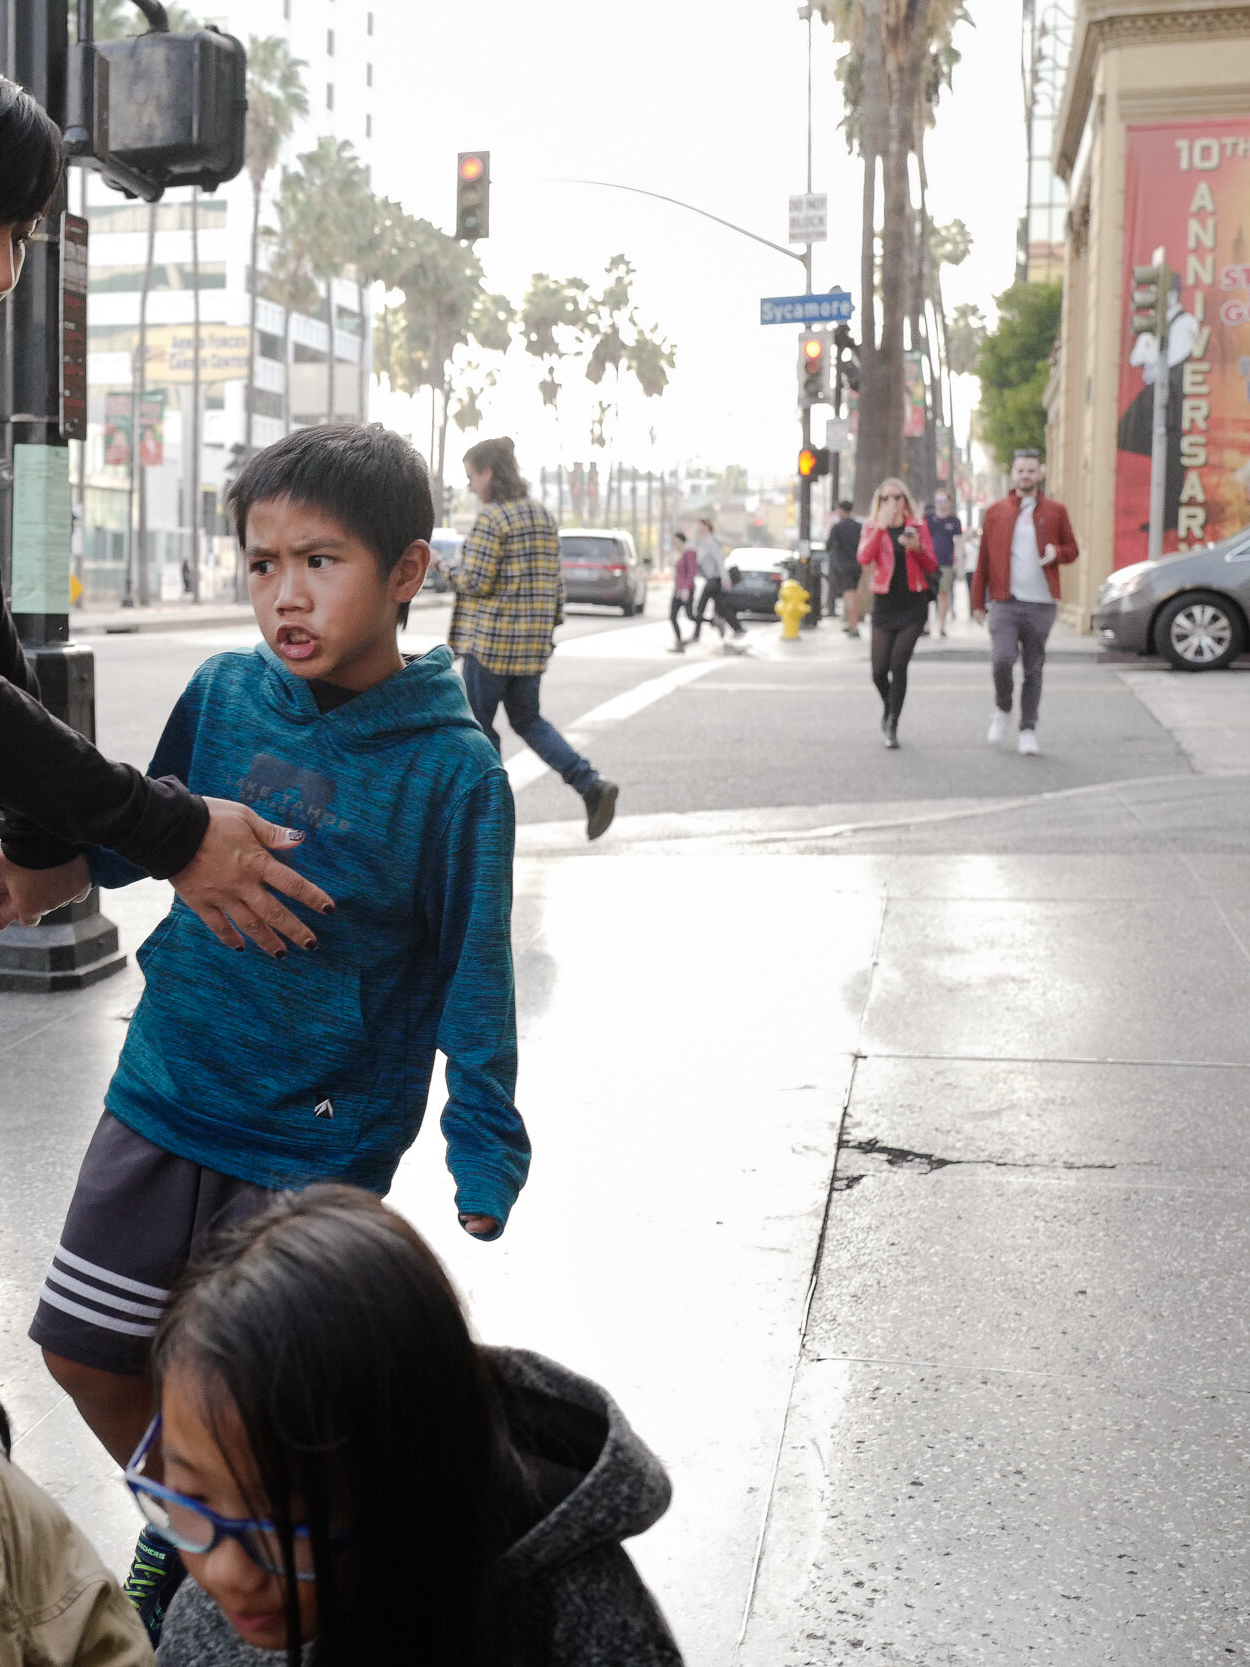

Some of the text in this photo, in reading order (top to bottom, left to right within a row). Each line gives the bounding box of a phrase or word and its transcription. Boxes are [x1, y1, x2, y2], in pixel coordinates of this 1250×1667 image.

[790, 214, 825, 230] BLOCK
[762, 300, 850, 322] Sycamore
[1176, 180, 1217, 553] ANNIVERSAR
